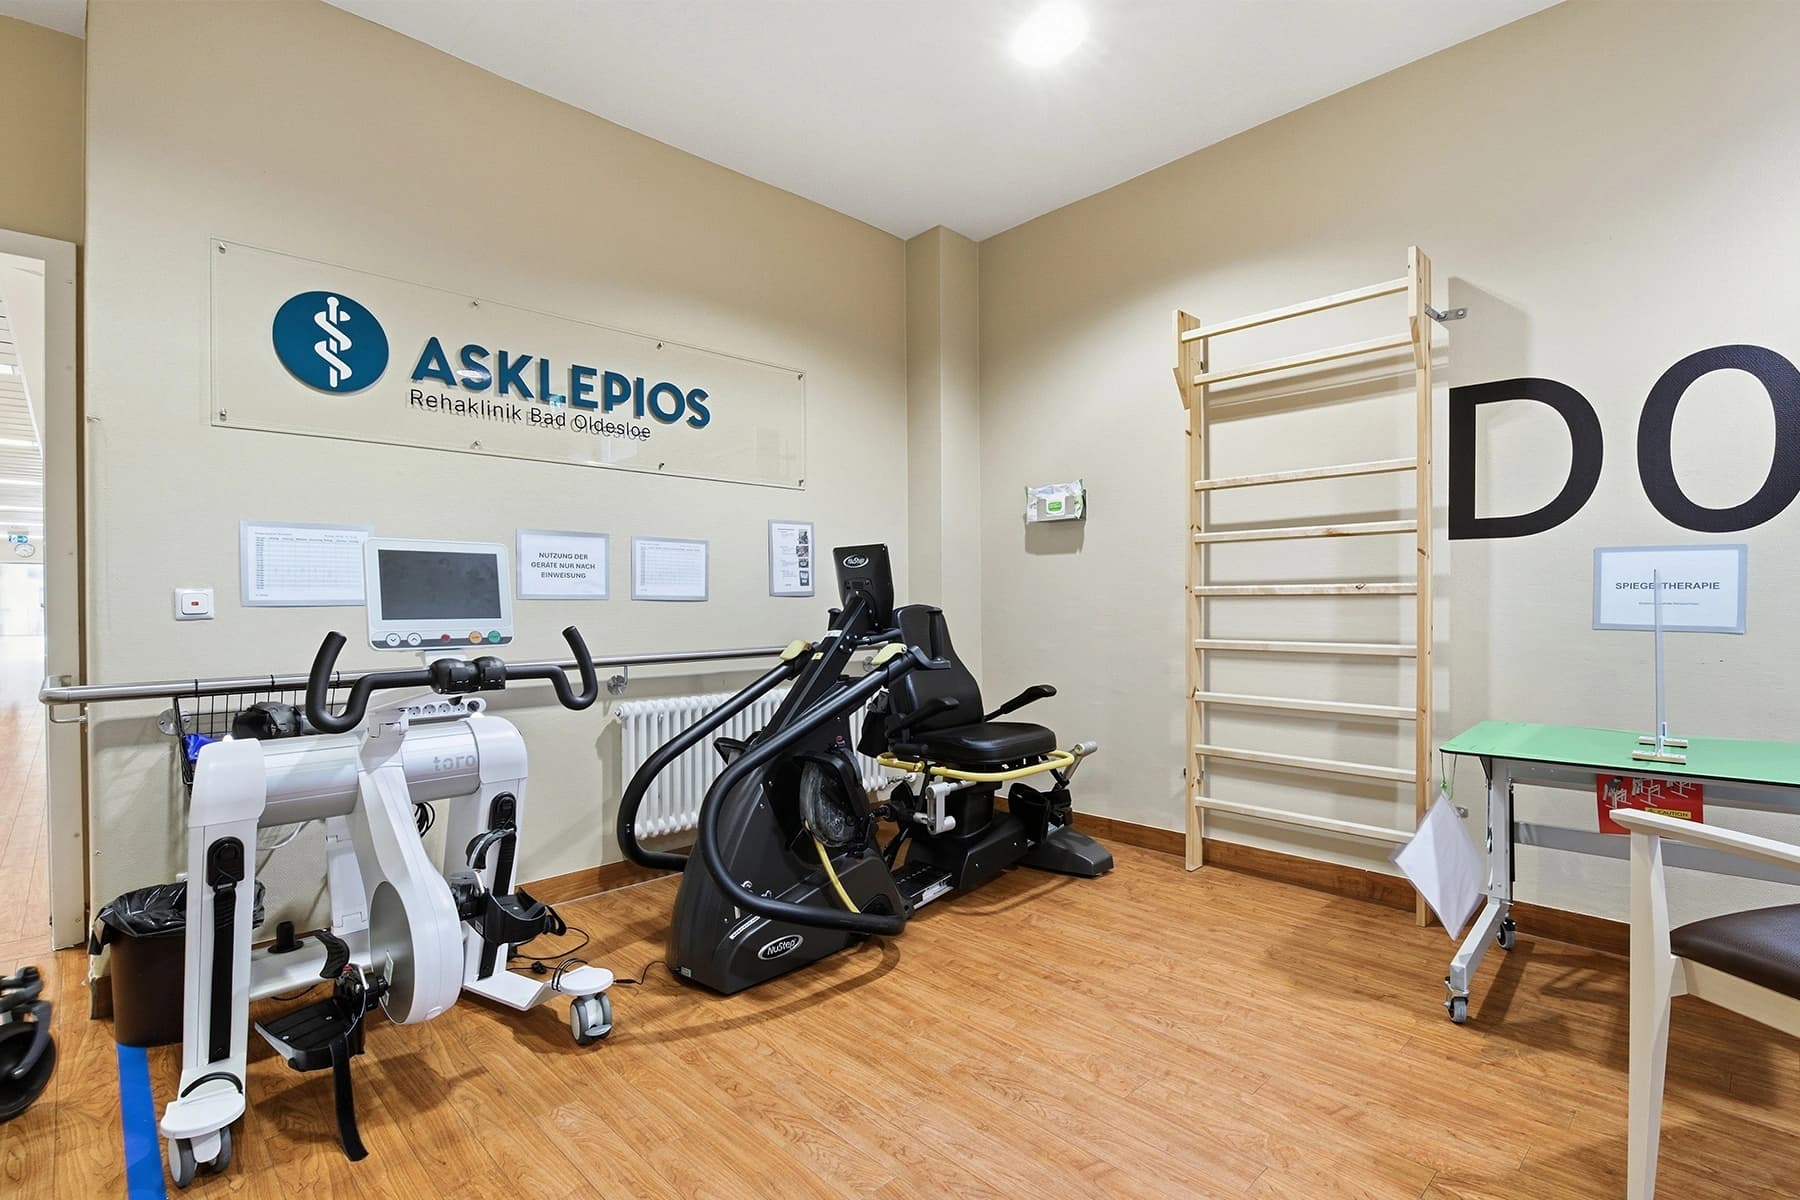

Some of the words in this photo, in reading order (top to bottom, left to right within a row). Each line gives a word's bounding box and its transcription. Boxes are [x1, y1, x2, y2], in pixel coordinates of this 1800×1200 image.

[410, 336, 711, 429] ASKLEPIOS
[409, 388, 522, 421] Rehaklinik
[530, 407, 566, 427] Bad
[574, 414, 651, 439] Oldesloe
[1448, 344, 1800, 540] DO
[1615, 582, 1720, 590] SPIEGETHERAPIE
[767, 938, 797, 956] NuStep
